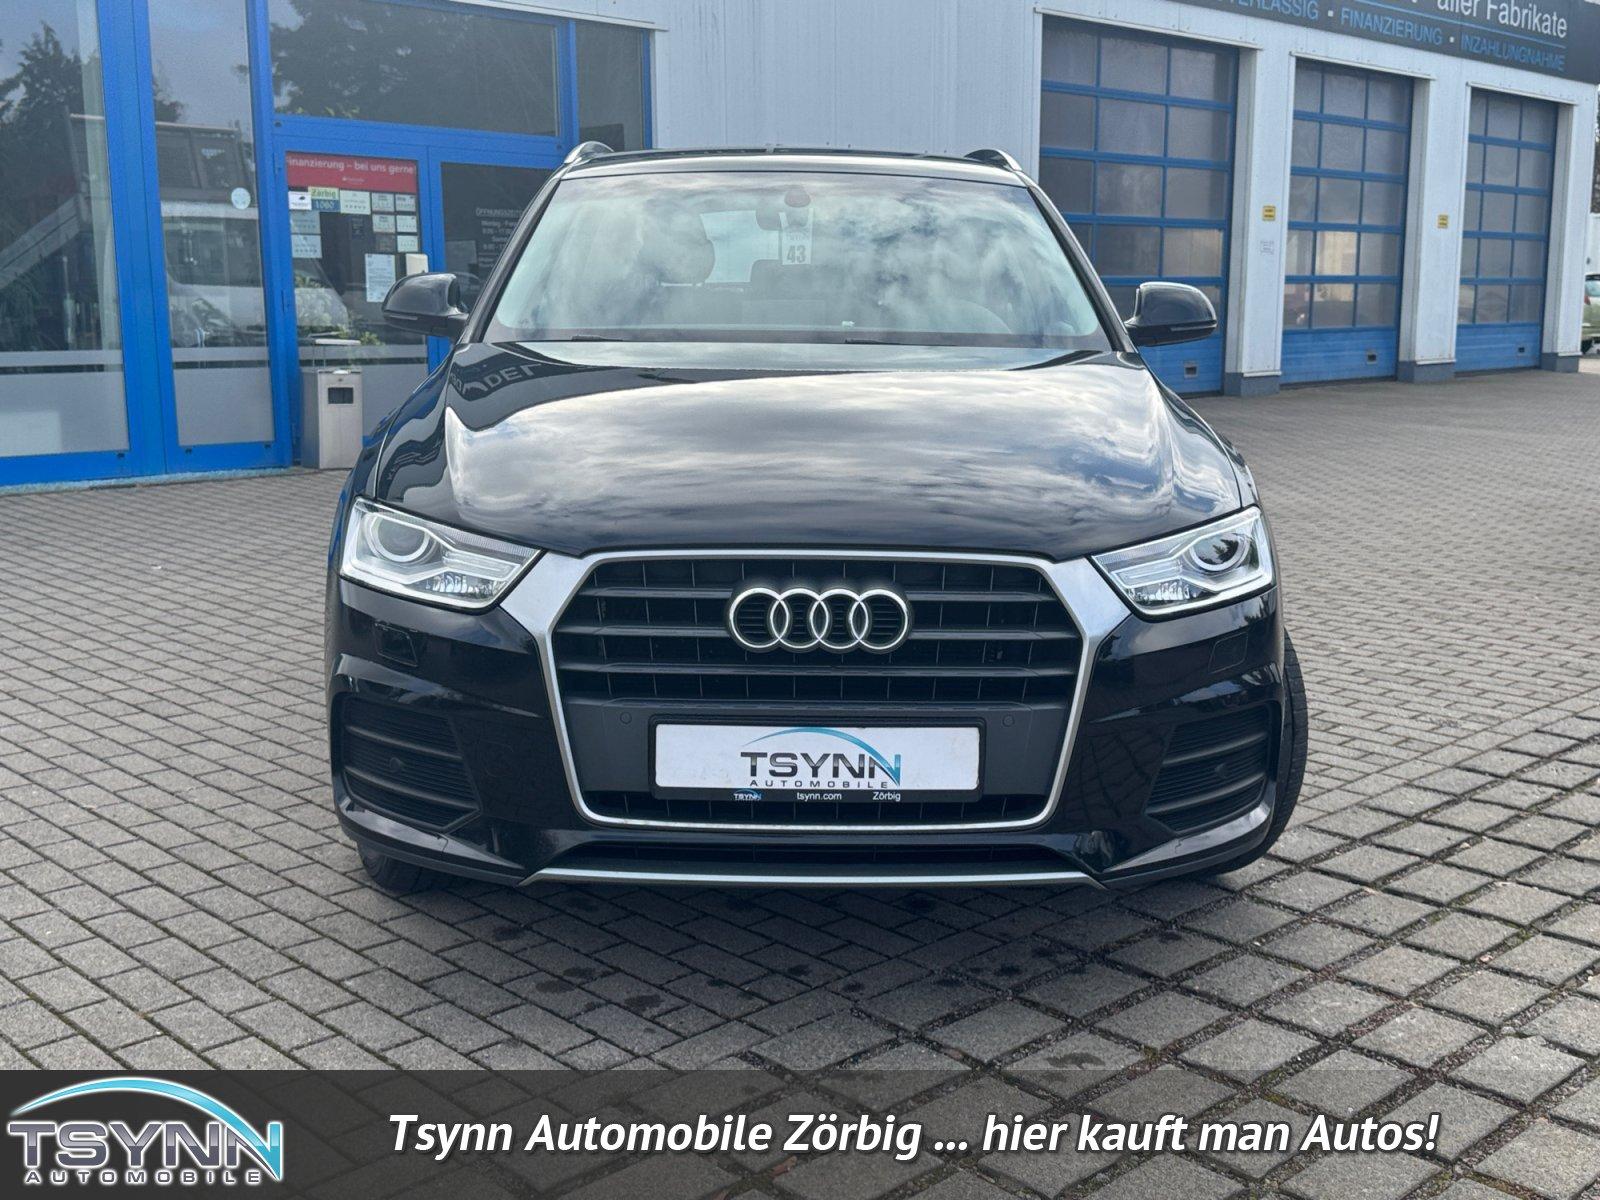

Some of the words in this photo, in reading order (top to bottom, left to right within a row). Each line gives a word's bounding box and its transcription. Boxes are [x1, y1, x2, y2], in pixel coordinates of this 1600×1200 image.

[1486, 0, 1568, 39] Fabrikate
[1340, 8, 1443, 46] FINANZIERUNG
[1461, 33, 1566, 71] INZAHLUNGNAHME
[354, 161, 369, 171] bei
[371, 164, 387, 172] uns
[787, 245, 806, 263] 43
[740, 751, 901, 782] TSYNN
[749, 779, 888, 789] AUTOMOBILE
[796, 791, 842, 802] tsynn.com
[872, 791, 901, 802] Zörbig
